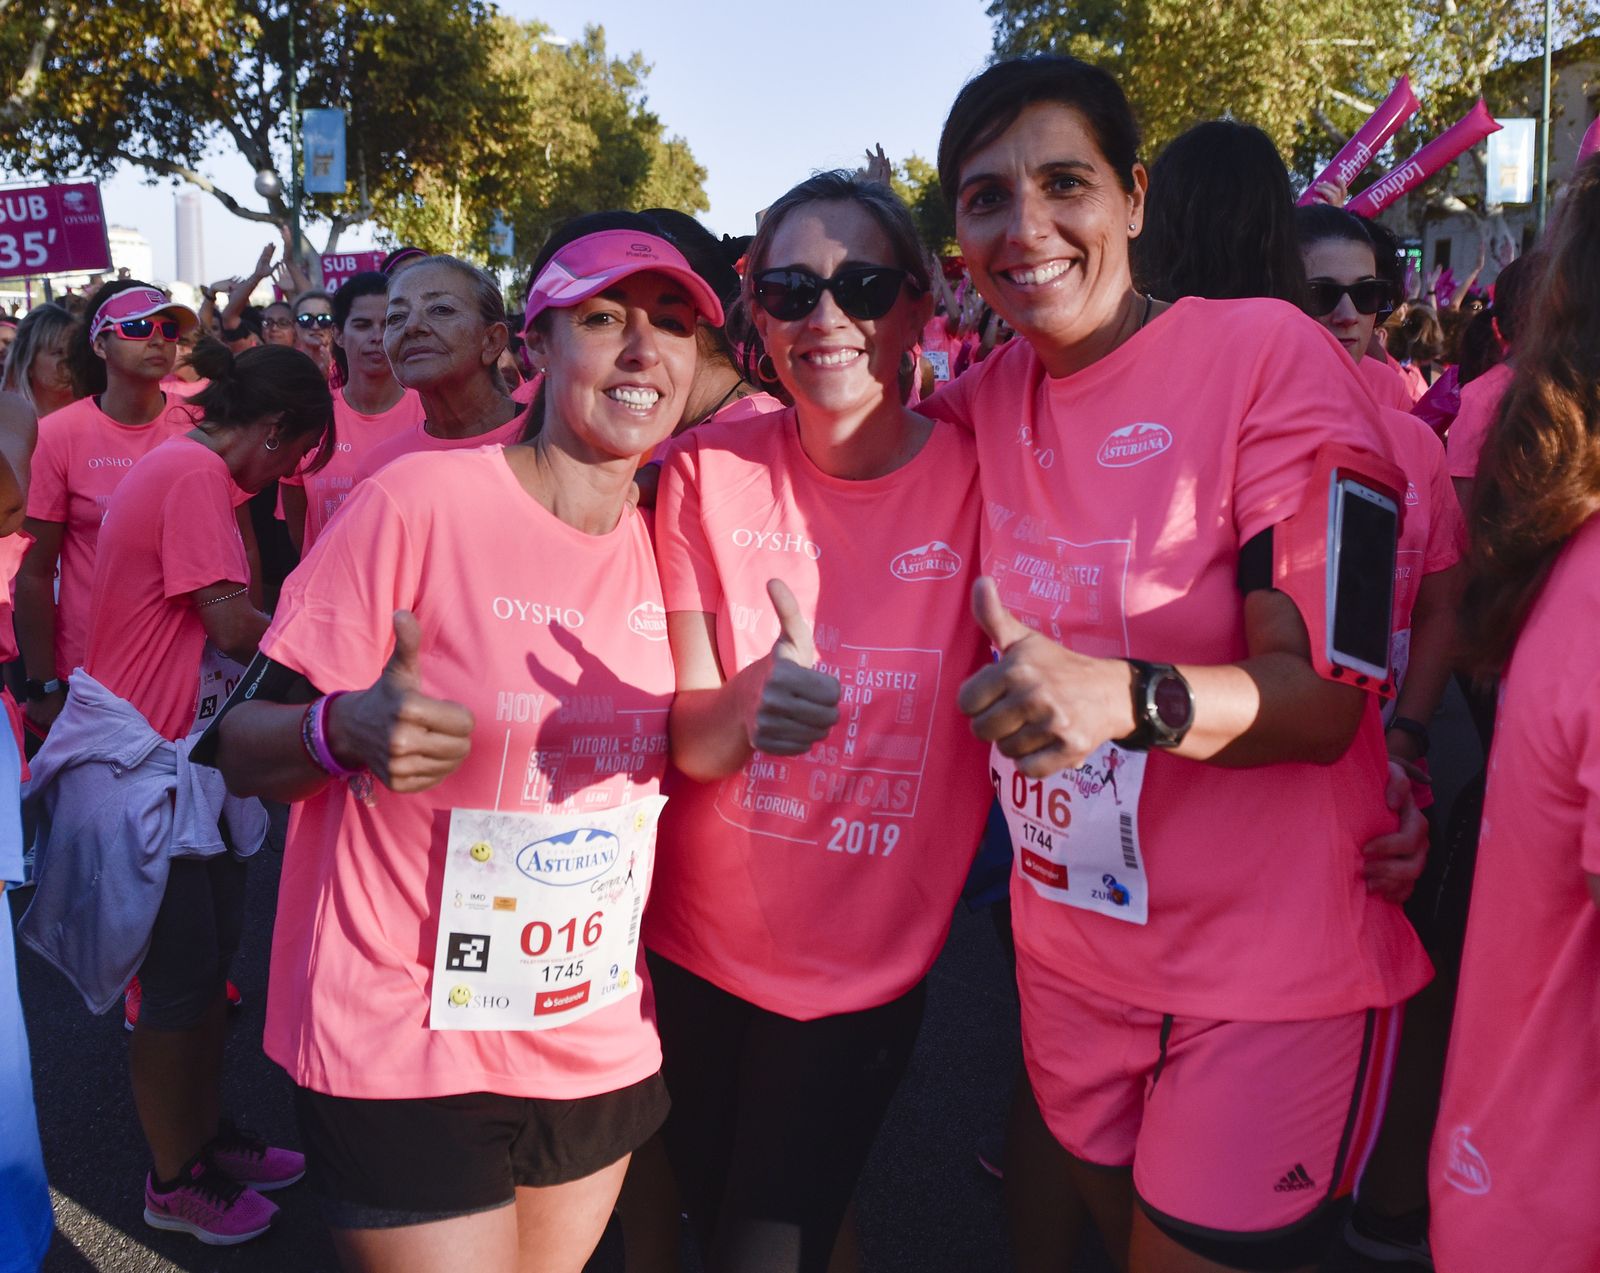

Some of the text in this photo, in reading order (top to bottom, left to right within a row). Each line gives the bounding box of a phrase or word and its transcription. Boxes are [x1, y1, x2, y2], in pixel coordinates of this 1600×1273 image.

[1367, 160, 1425, 209] Ladival
[64, 214, 100, 225] OYSHO
[323, 255, 357, 273] SUB
[1102, 437, 1164, 461] ASTURIANA
[88, 456, 133, 469] OYSHO
[731, 528, 822, 561] OYSHO
[896, 558, 957, 575] ASTURIANA
[1028, 576, 1071, 603] MADRID
[492, 596, 585, 629] OYSHO
[855, 670, 918, 690] GASTEIZ
[495, 691, 545, 724] HOY
[843, 686, 873, 705] RID
[571, 736, 669, 754] VITORIA GASTE
[594, 755, 645, 772] MADRID
[808, 769, 911, 810] CHICAS
[1011, 770, 1072, 830] 016
[755, 794, 807, 820] CORUÑA
[827, 816, 900, 857] 2019
[1023, 821, 1053, 853] 1744
[525, 848, 615, 873] ASTURIANA
[520, 910, 604, 957] 016
[541, 959, 584, 983] 1745
[448, 995, 510, 1009] SHO
[553, 989, 585, 1008] Santander
